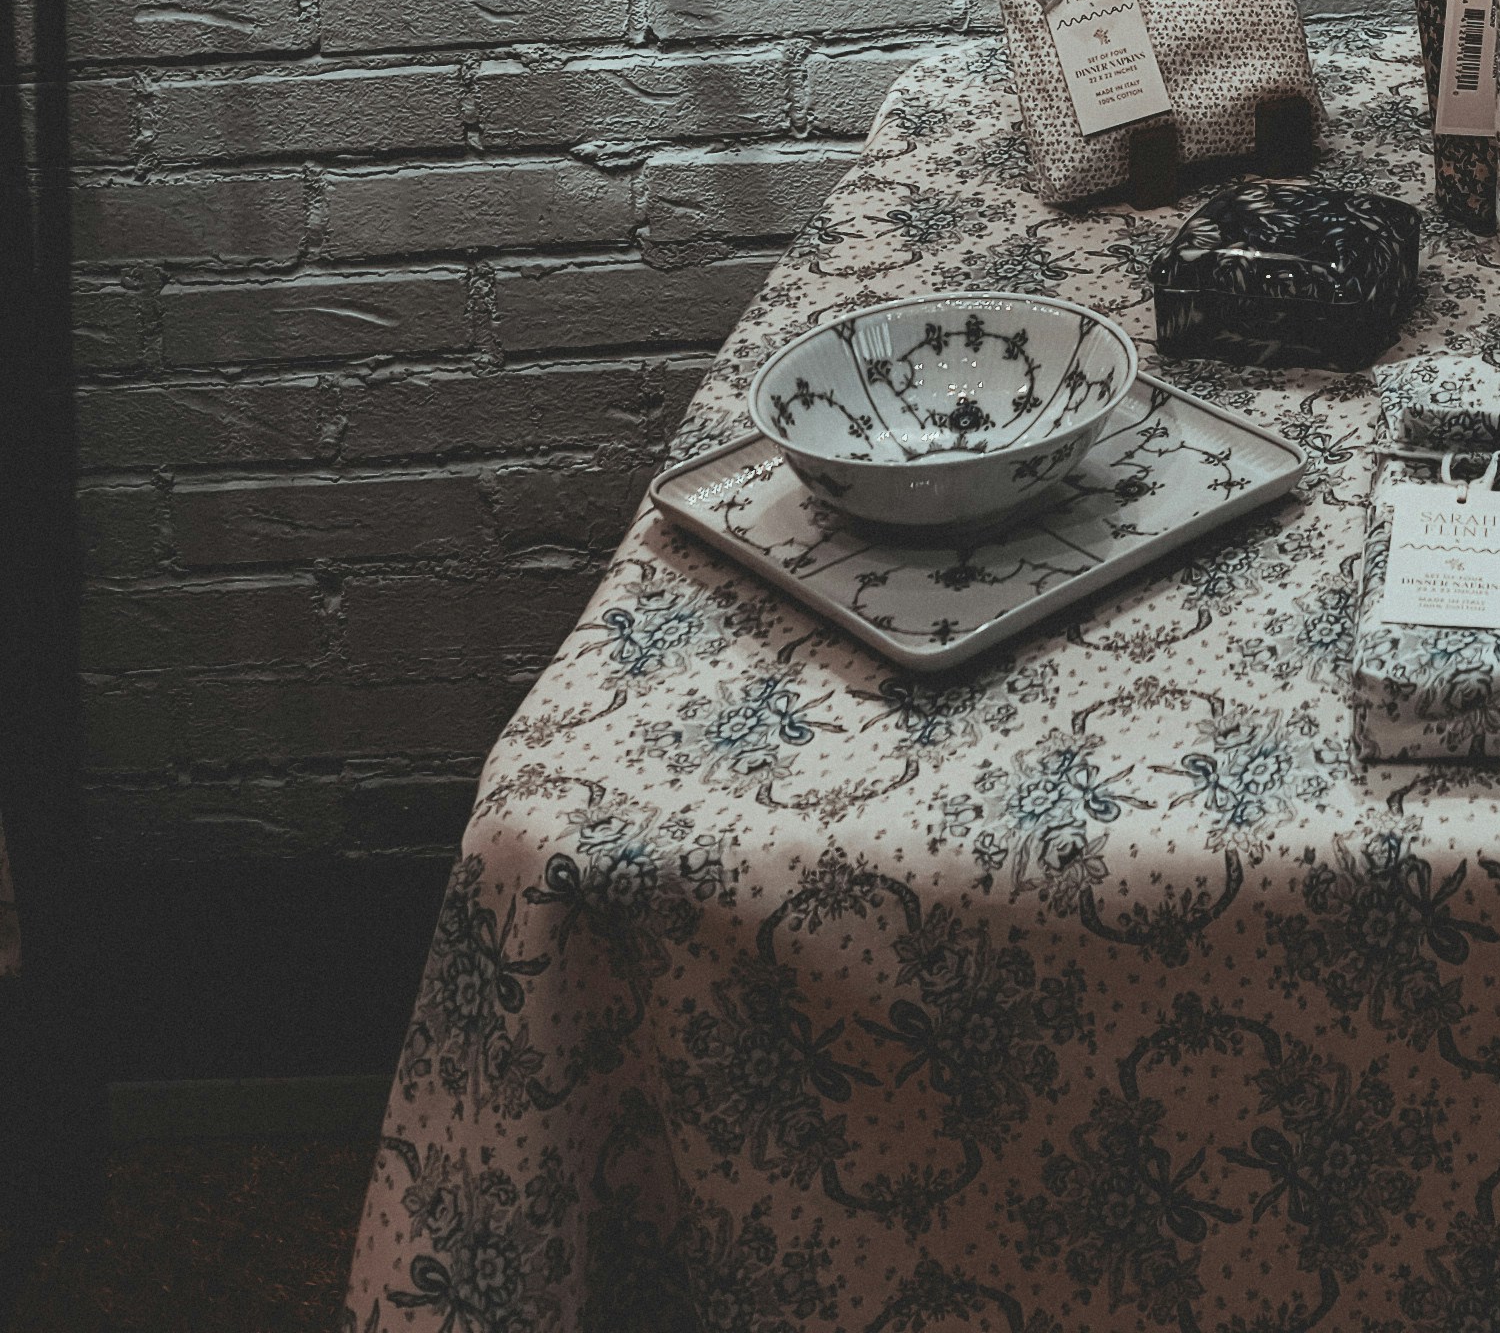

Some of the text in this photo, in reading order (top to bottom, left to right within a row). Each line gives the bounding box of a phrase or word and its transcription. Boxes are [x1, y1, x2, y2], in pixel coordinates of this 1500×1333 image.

[1075, 52, 1146, 79] DINNER NAPKINS
[1095, 87, 1114, 97] MADE
[1116, 87, 1144, 101] COTTON
[1420, 511, 1496, 527] SARAH
[1424, 523, 1489, 538] FLINT
[1401, 577, 1448, 586] DINNER
